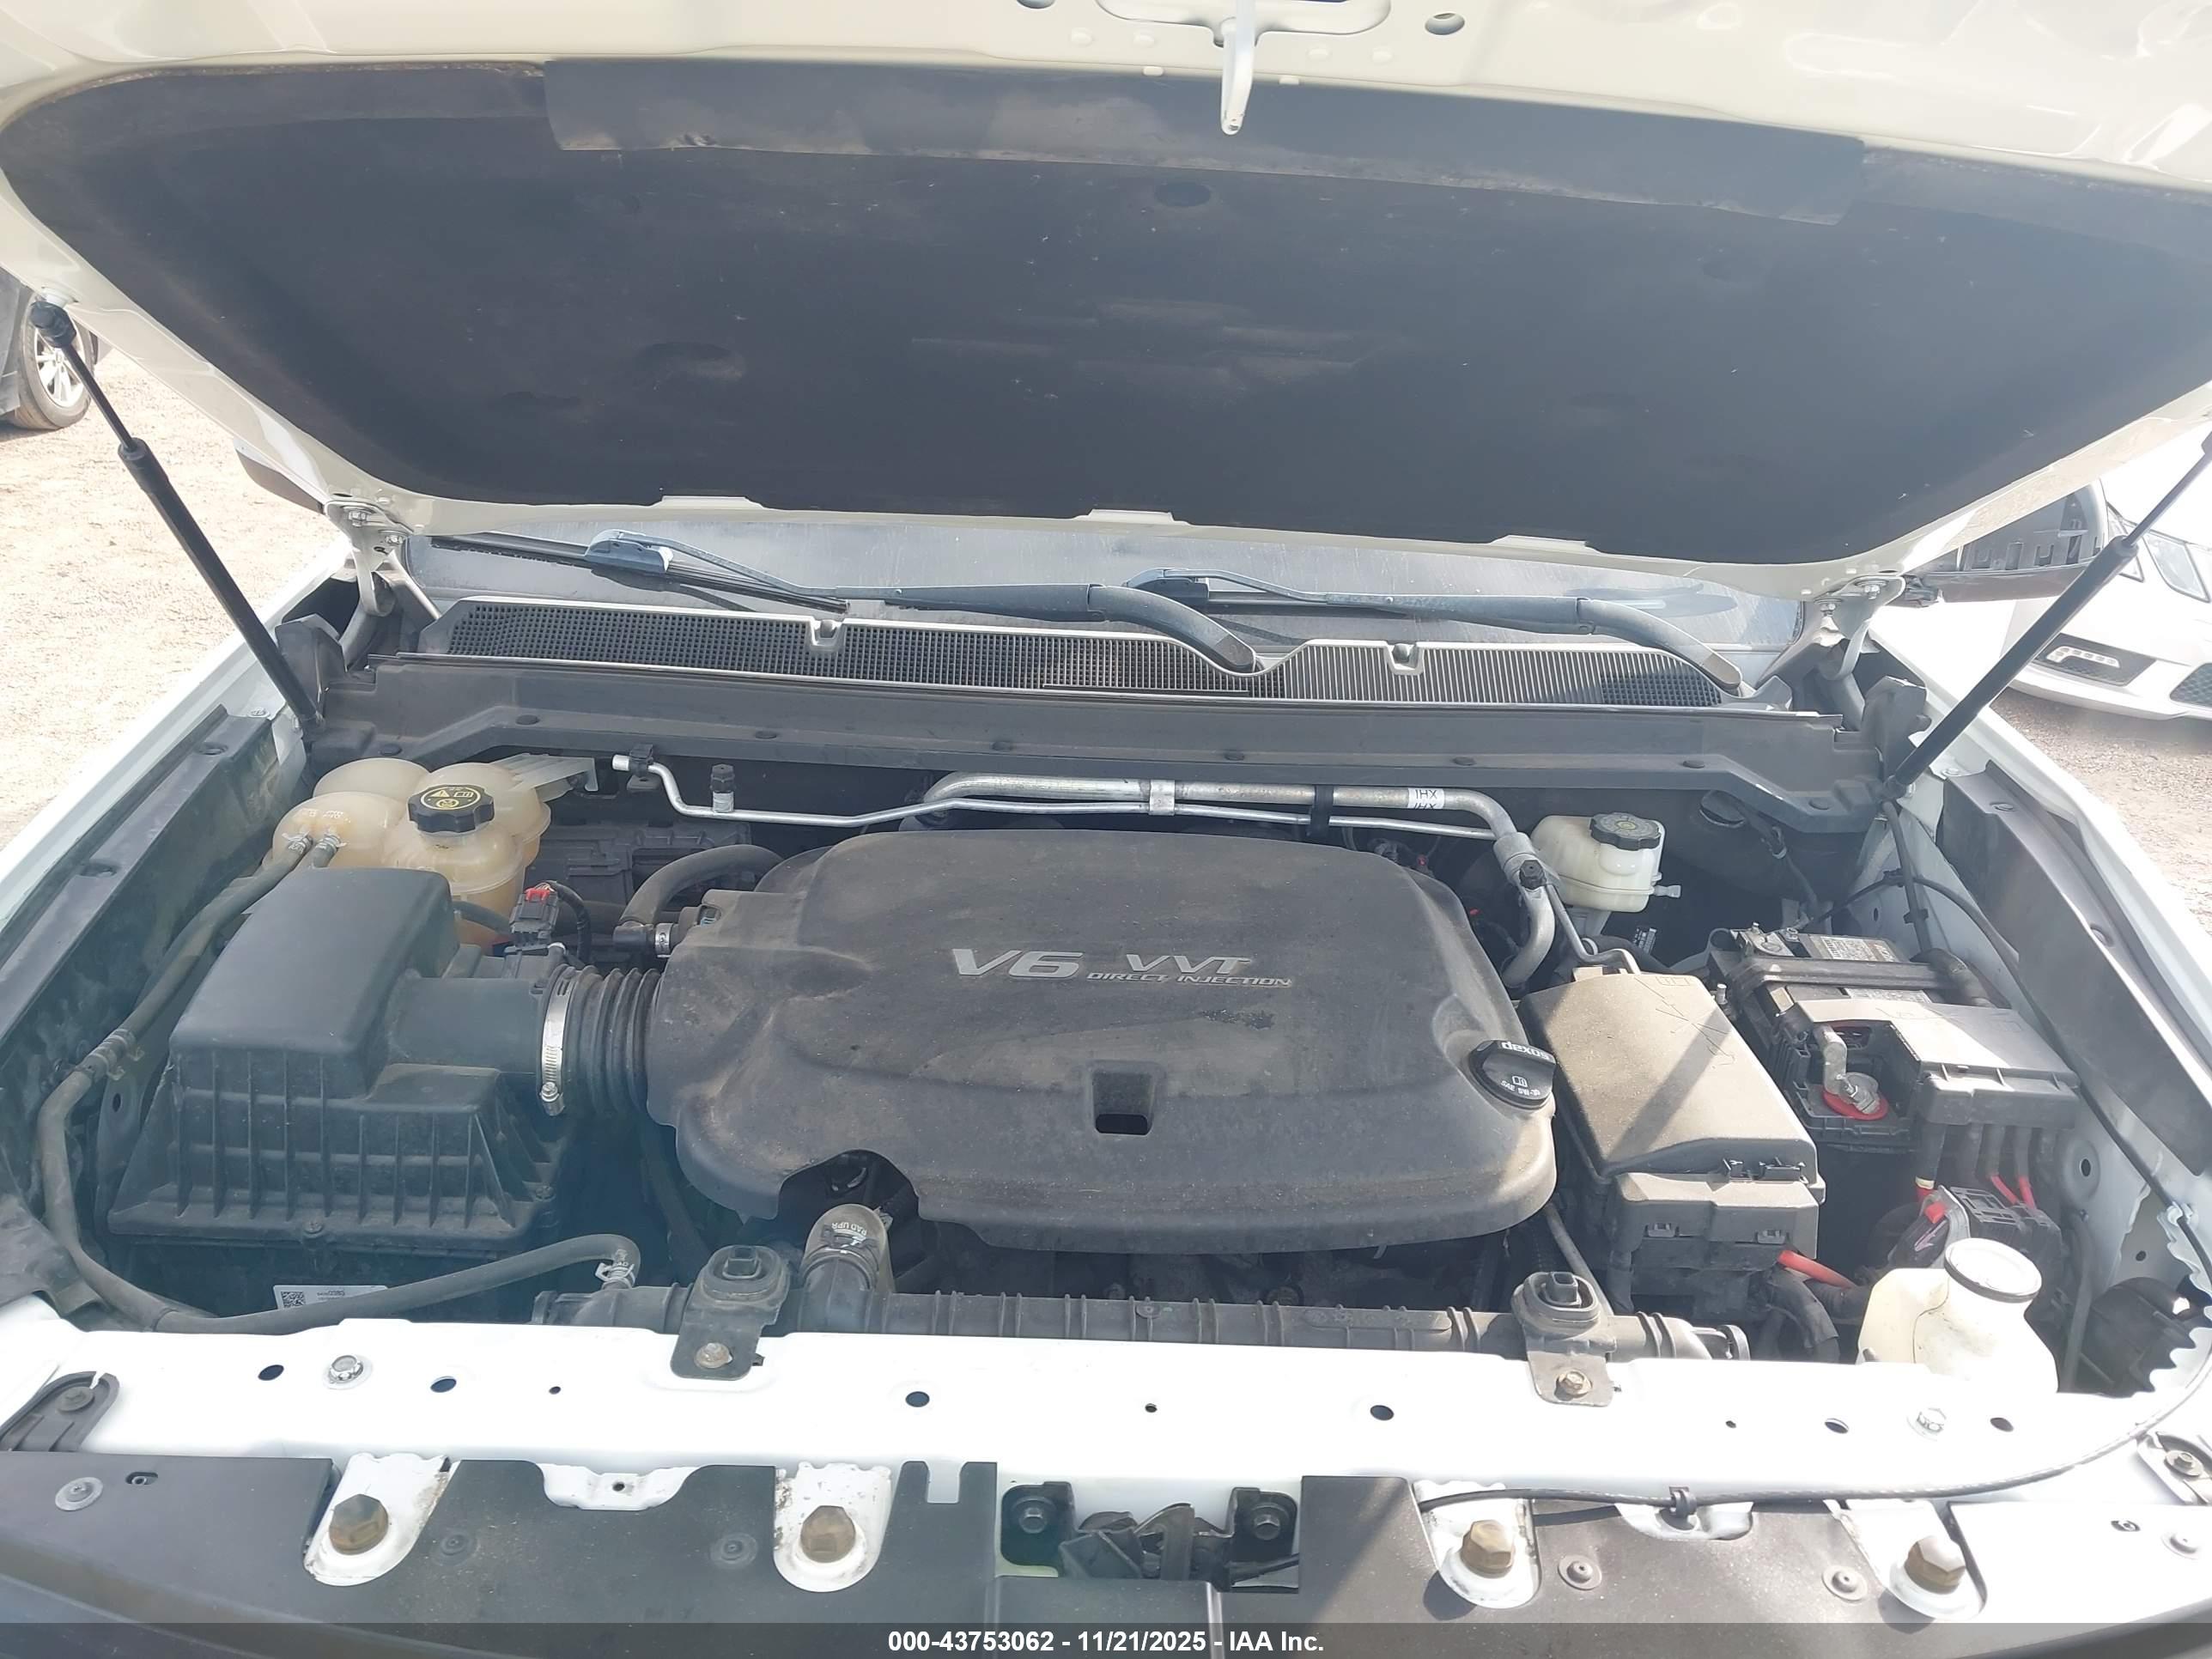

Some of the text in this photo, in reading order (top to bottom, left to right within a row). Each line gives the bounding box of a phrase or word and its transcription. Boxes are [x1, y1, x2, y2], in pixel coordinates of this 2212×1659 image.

[952, 948, 1253, 979] V6 VVT
[1086, 971, 1291, 988] DIRECT INJECTION
[1501, 1041, 1550, 1060] dexos
